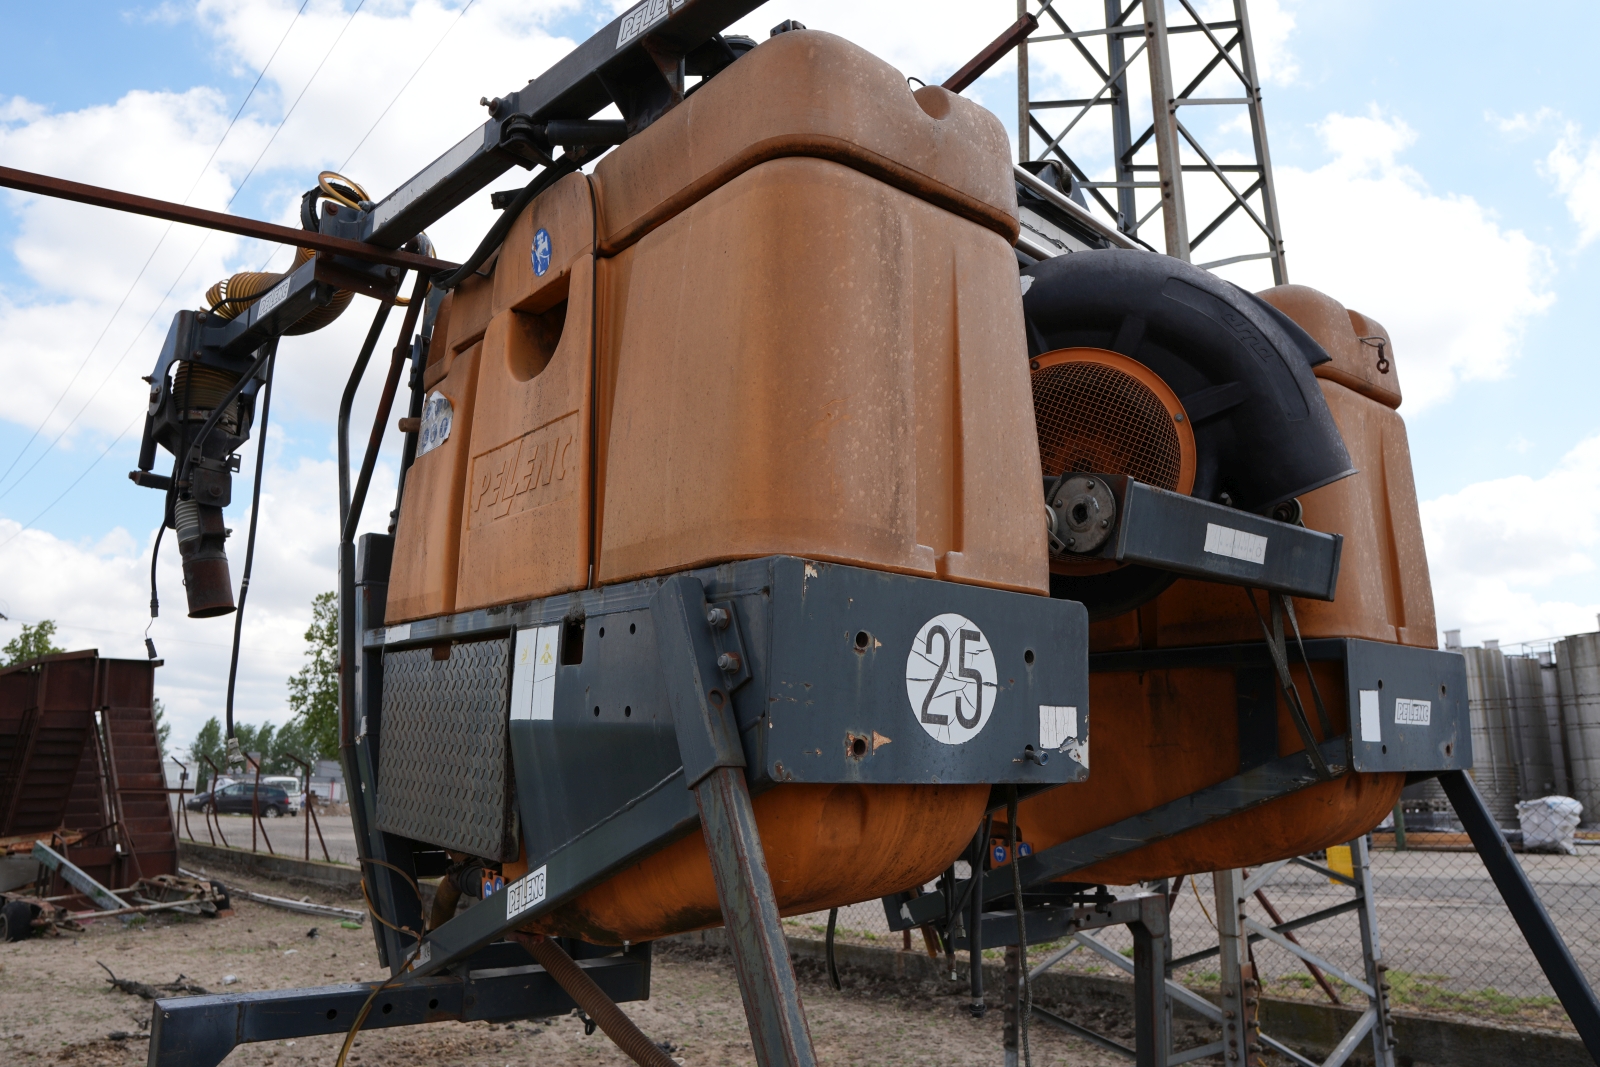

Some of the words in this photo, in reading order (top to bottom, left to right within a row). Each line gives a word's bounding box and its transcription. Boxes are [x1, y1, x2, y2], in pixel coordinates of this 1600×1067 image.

[473, 433, 573, 520] PELLENC
[920, 624, 983, 730] 25
[1396, 702, 1429, 722] PELLENC
[508, 872, 544, 915] PELLENC
